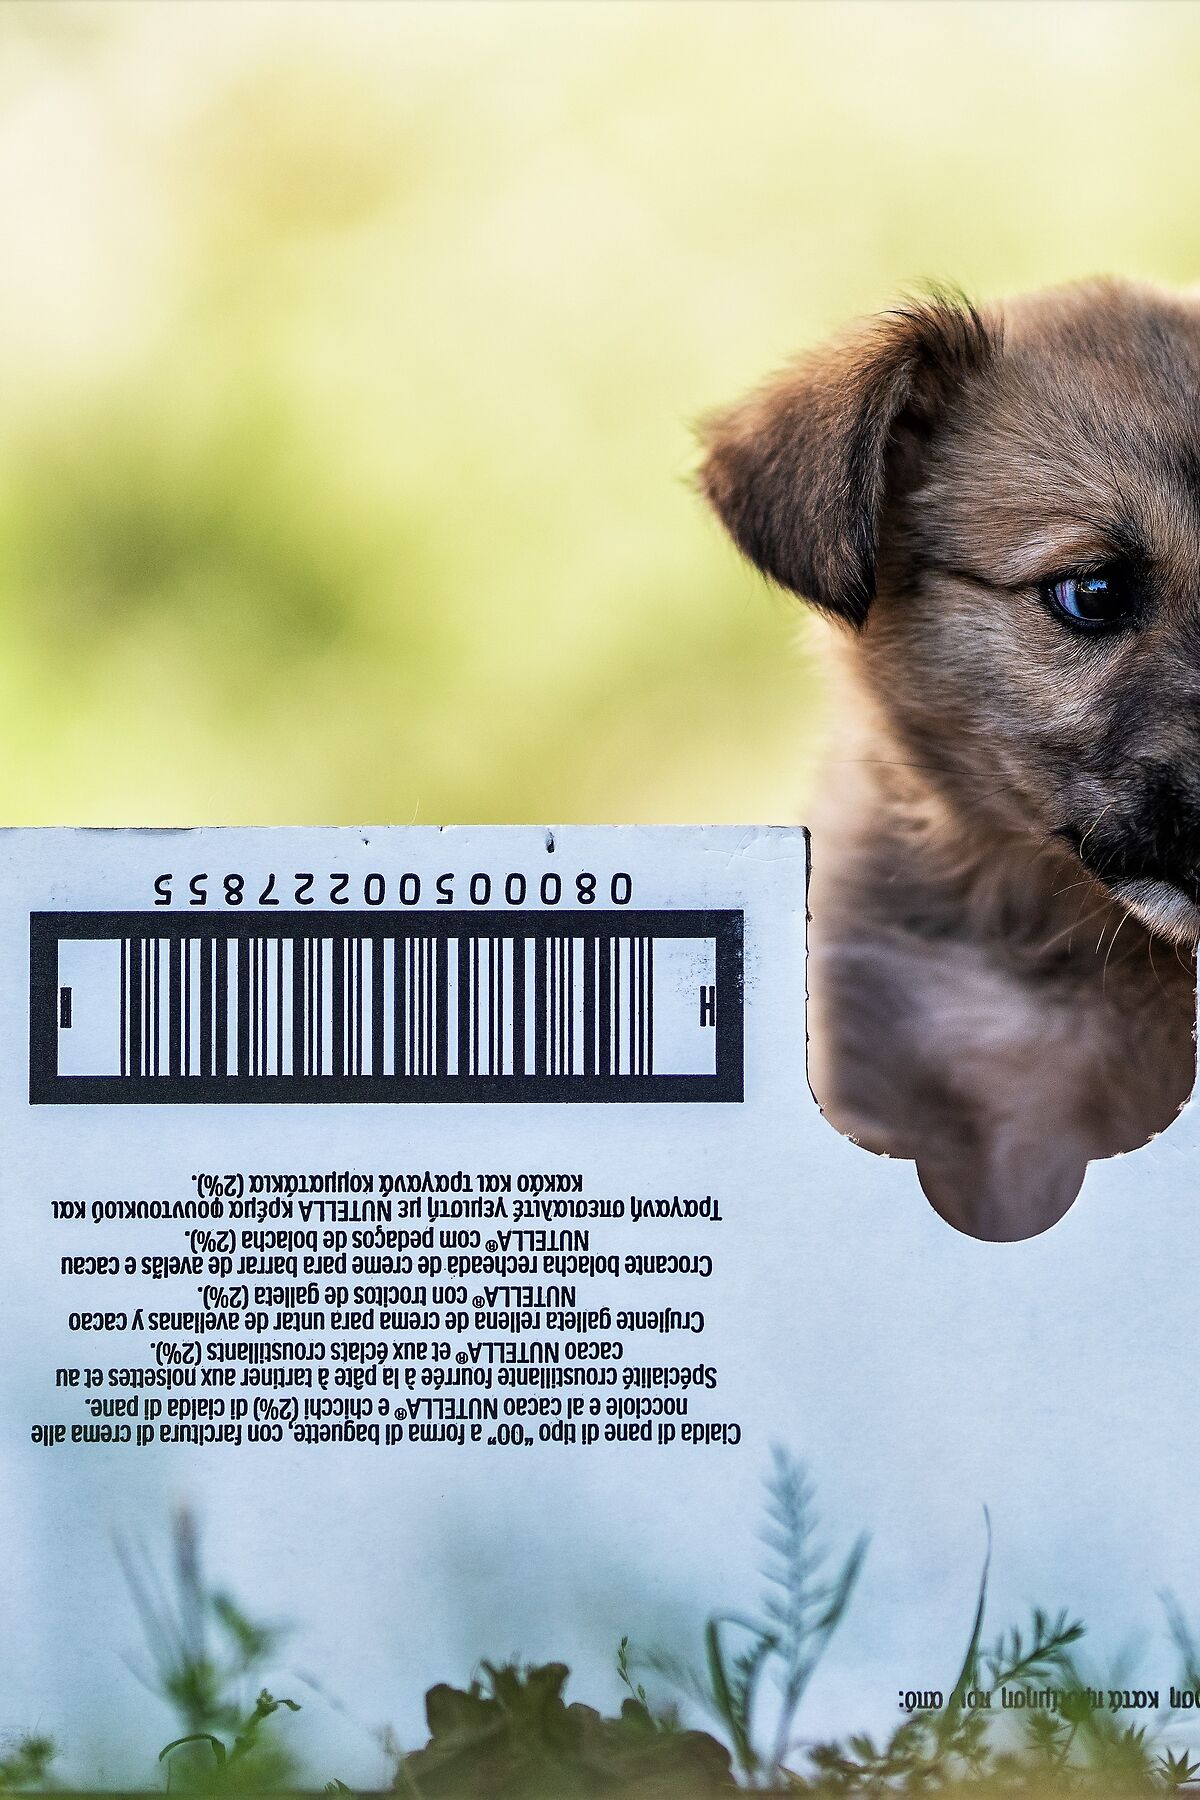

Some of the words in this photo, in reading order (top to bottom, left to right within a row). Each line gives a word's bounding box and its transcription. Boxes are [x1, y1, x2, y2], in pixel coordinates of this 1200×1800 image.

[151, 871, 633, 905] 08000500227855
[191, 1172, 245, 1199] (2%).
[247, 1170, 374, 1198] κομματάκια
[377, 1170, 473, 1198] τραγανά
[475, 1173, 512, 1193] και
[516, 1173, 583, 1198] κακάο
[50, 1200, 87, 1220] και
[91, 1196, 225, 1225] φουντουκιού
[227, 1196, 294, 1224] κρέμα
[297, 1199, 393, 1223] NUTELLA
[397, 1195, 422, 1219] με
[427, 1195, 509, 1223] γεμιστή
[512, 1199, 625, 1223] σπεσιαλιτέ
[630, 1195, 723, 1223] Τραγανή
[184, 1228, 237, 1255] (2%).
[241, 1230, 318, 1253] bolacha
[322, 1230, 348, 1253] de
[351, 1224, 435, 1253] pedaços
[439, 1229, 481, 1249] com
[484, 1228, 590, 1254] NUTELLA®
[60, 1255, 121, 1276] cacau
[124, 1255, 137, 1275] e
[140, 1255, 204, 1280] avelãs
[207, 1255, 233, 1279] de
[236, 1255, 298, 1279] barrar
[303, 1251, 347, 1275] para
[351, 1255, 413, 1275] creme
[417, 1255, 443, 1279] de
[446, 1255, 538, 1278] recheada
[542, 1254, 620, 1278] bolacha
[624, 1254, 713, 1278] Crocante
[197, 1284, 249, 1311] (2%).
[254, 1281, 320, 1309] galleta
[324, 1285, 349, 1309] de
[353, 1285, 427, 1309] trocitos
[431, 1285, 468, 1305] con
[471, 1285, 576, 1309] NUTELLA®
[68, 1311, 128, 1332] cacao
[131, 1308, 145, 1331] y
[147, 1311, 240, 1335] avellanas
[243, 1311, 270, 1335] de
[272, 1311, 326, 1333] untar
[330, 1307, 375, 1331] para
[379, 1311, 441, 1331] crema
[444, 1311, 470, 1334] de
[474, 1311, 541, 1334] rellena
[545, 1306, 612, 1334] galleta
[615, 1307, 705, 1334] Crujiente
[149, 1340, 203, 1367] (2%).
[206, 1341, 326, 1365] croustillants
[329, 1341, 389, 1365] éclats
[391, 1341, 428, 1361] aux
[431, 1341, 452, 1363] et
[455, 1341, 560, 1365] NUTELLA®
[564, 1341, 624, 1361] cacao
[55, 1367, 81, 1387] au
[83, 1367, 105, 1389] et
[107, 1366, 197, 1391] noisettes
[200, 1367, 237, 1387] aux
[239, 1365, 313, 1390] tartiner
[317, 1367, 330, 1391] à
[333, 1363, 377, 1391] pâte
[382, 1367, 400, 1390] la
[404, 1367, 417, 1391] à
[420, 1366, 493, 1391] fourrée
[497, 1367, 618, 1390] croustillante
[621, 1363, 718, 1391] Spécialité
[84, 1394, 139, 1418] pane.
[143, 1398, 163, 1421] di
[167, 1397, 226, 1421] cialda
[230, 1397, 249, 1421] di
[253, 1395, 299, 1421] (2%)
[303, 1397, 374, 1421] chicchi
[377, 1397, 391, 1417] e
[393, 1397, 499, 1421] NUTELLA®
[503, 1396, 563, 1417] cacao
[567, 1397, 585, 1420] al
[588, 1397, 602, 1417] e
[605, 1397, 688, 1420] nocciole
[30, 1423, 67, 1447] alle
[70, 1423, 132, 1444] crema
[136, 1423, 155, 1447] di
[159, 1423, 243, 1447] farcitura
[247, 1423, 284, 1443] con
[287, 1419, 380, 1447] baguette,
[385, 1423, 404, 1446] di
[408, 1422, 465, 1446] forma
[470, 1423, 483, 1442] a
[538, 1419, 577, 1446] tipo
[581, 1423, 600, 1446] di
[603, 1419, 653, 1442] pane
[657, 1422, 676, 1446] di
[680, 1422, 742, 1446] Cialda
[897, 1690, 944, 1714] από:
